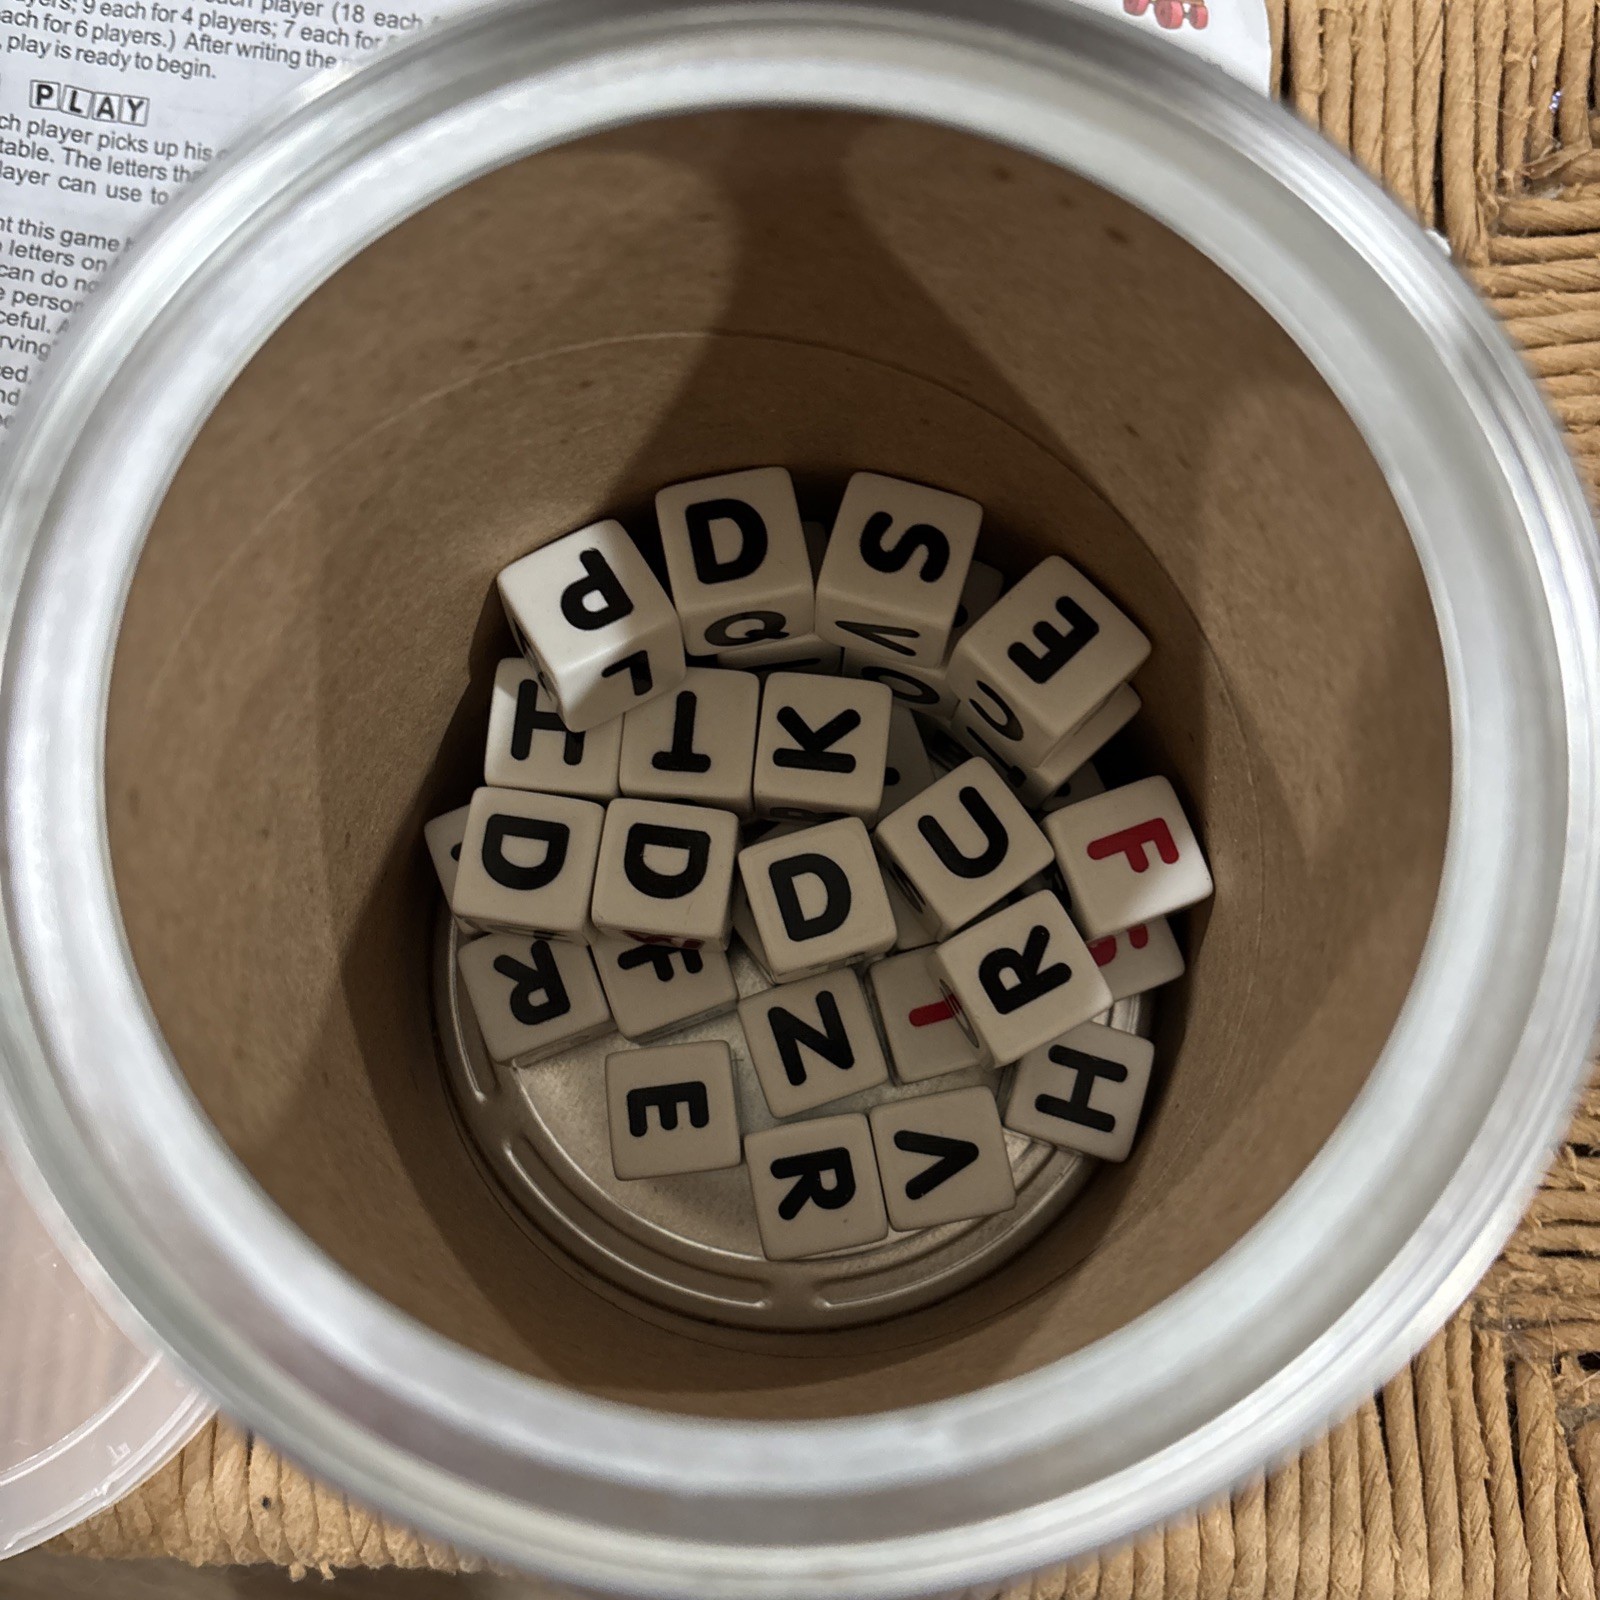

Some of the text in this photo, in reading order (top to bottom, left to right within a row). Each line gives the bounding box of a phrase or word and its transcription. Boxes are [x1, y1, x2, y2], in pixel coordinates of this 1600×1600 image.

[43, 13, 72, 34] for
[75, 20, 88, 38] 6
[91, 22, 176, 53] players.)
[183, 32, 232, 55] After
[236, 42, 300, 69] writing
[305, 50, 337, 69] the
[100, 1, 146, 20] each
[151, 2, 178, 23] for
[181, 7, 193, 25] 4
[198, 10, 277, 38] players;
[284, 19, 296, 38] 7
[301, 26, 349, 47] each
[332, 1, 365, 24] (18
[7, 33, 217, 79] play is ready to begin.
[34, 82, 147, 124] PLAY
[26, 118, 93, 144] player
[97, 132, 148, 154] picks
[154, 141, 179, 160] up
[184, 140, 212, 161] his
[61, 147, 101, 171] The
[107, 155, 167, 181] letters
[58, 174, 97, 195] can
[106, 184, 142, 202] use
[150, 187, 169, 205] to
[9, 240, 75, 267] letters
[81, 257, 107, 272] on
[18, 218, 55, 240] this
[60, 229, 120, 252] game
[41, 269, 68, 288] do
[685, 498, 768, 585] D
[860, 511, 950, 583] S
[561, 547, 634, 631] P
[704, 610, 790, 647] Q
[1007, 595, 1099, 684] E
[510, 679, 586, 766] H
[651, 690, 712, 773] T
[772, 705, 861, 774] K
[481, 813, 570, 891] D
[623, 822, 711, 899] D
[917, 786, 1009, 879] U
[1086, 817, 1179, 873] F
[768, 852, 852, 942] D
[493, 939, 571, 1025] R
[978, 924, 1072, 1015] R
[626, 1080, 710, 1138] E
[1034, 1044, 1128, 1133] H
[769, 1146, 856, 1221] R
[893, 1129, 980, 1200] V
